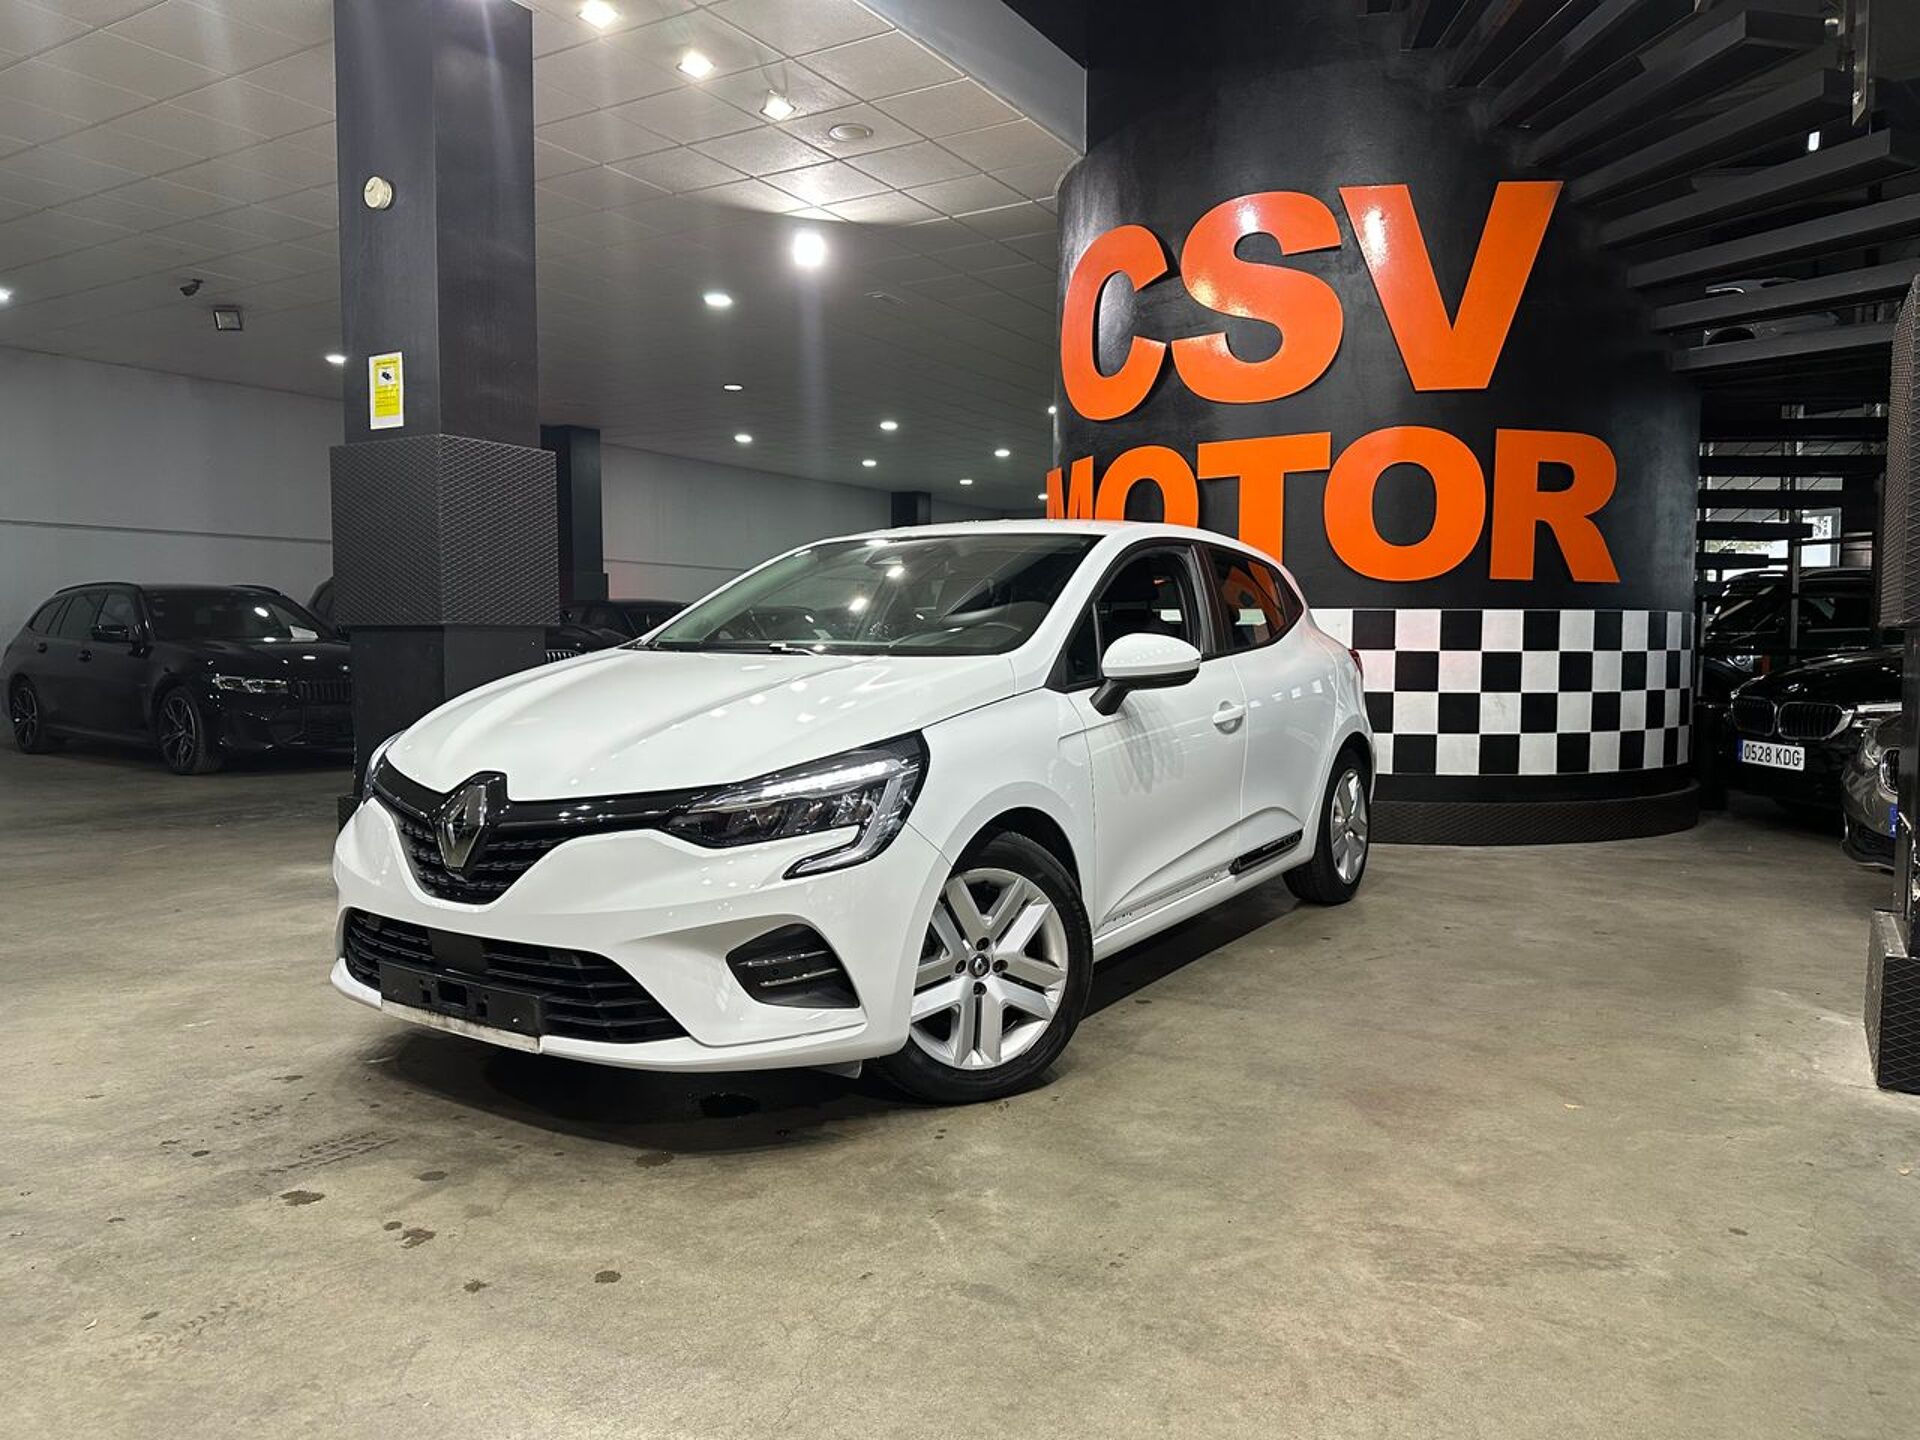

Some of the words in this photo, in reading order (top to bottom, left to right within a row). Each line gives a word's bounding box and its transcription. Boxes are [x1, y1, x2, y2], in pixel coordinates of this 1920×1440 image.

[1061, 181, 1563, 421] CSV
[1744, 744, 1772, 763] 0528
[1775, 748, 1802, 766] KDG
